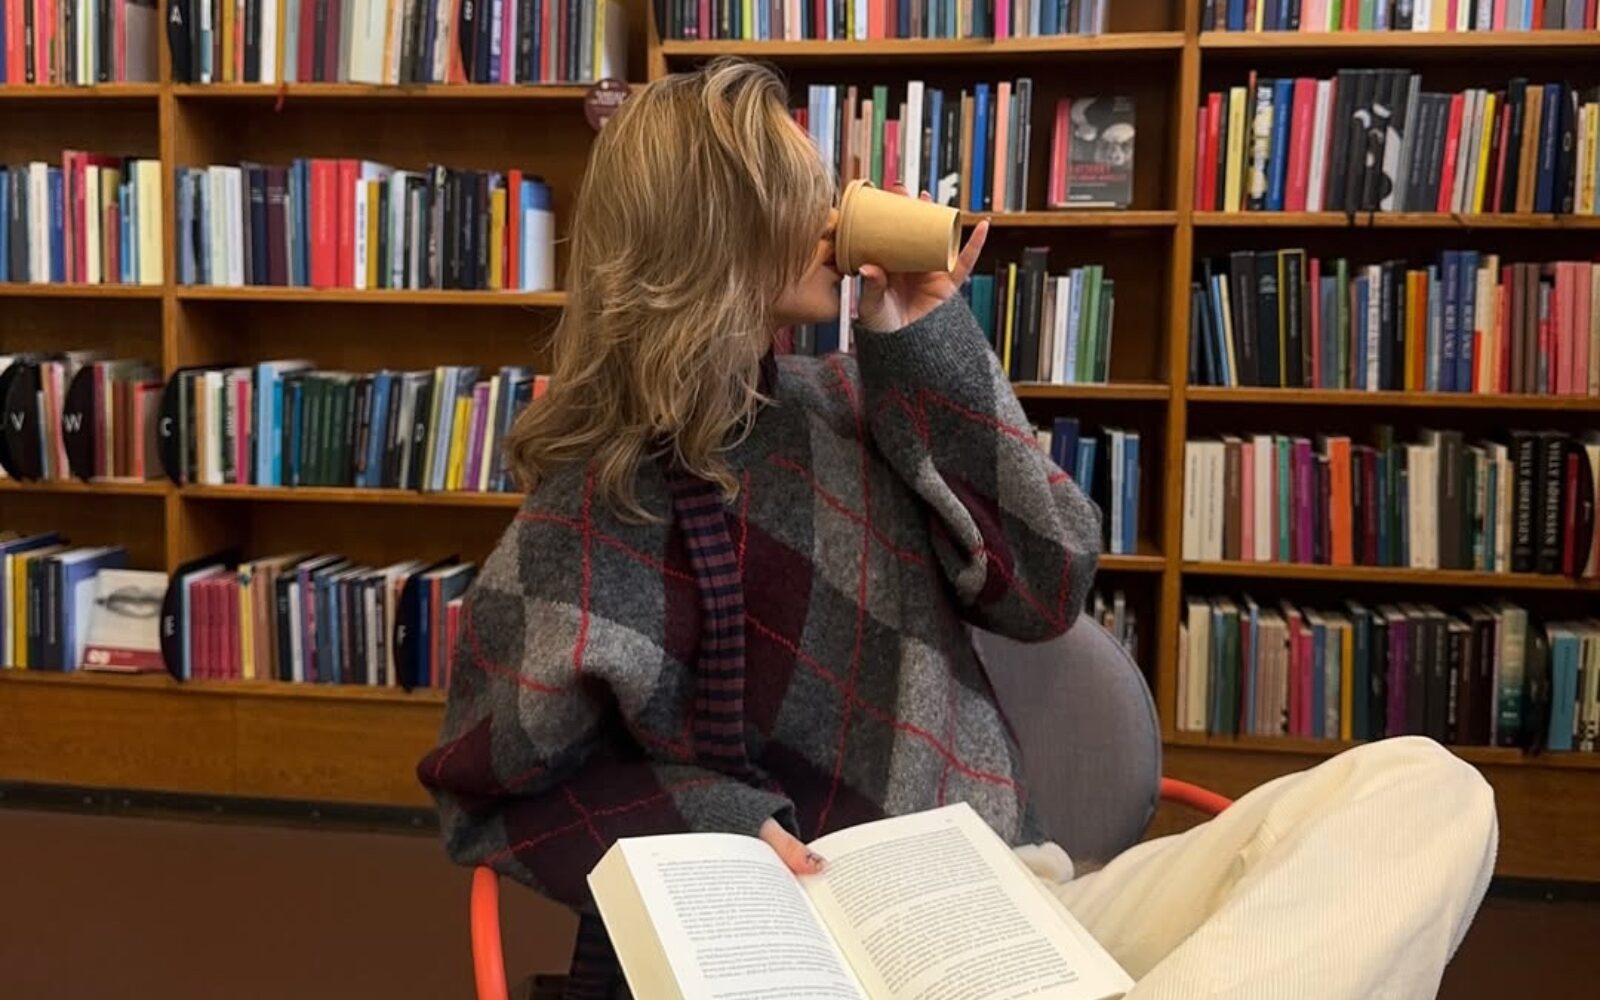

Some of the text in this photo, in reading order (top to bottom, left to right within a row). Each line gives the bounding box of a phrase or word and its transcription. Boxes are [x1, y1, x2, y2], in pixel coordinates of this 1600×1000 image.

[170, 5, 182, 25] A
[10, 411, 25, 431] V
[63, 411, 83, 433] W
[160, 416, 172, 437] C
